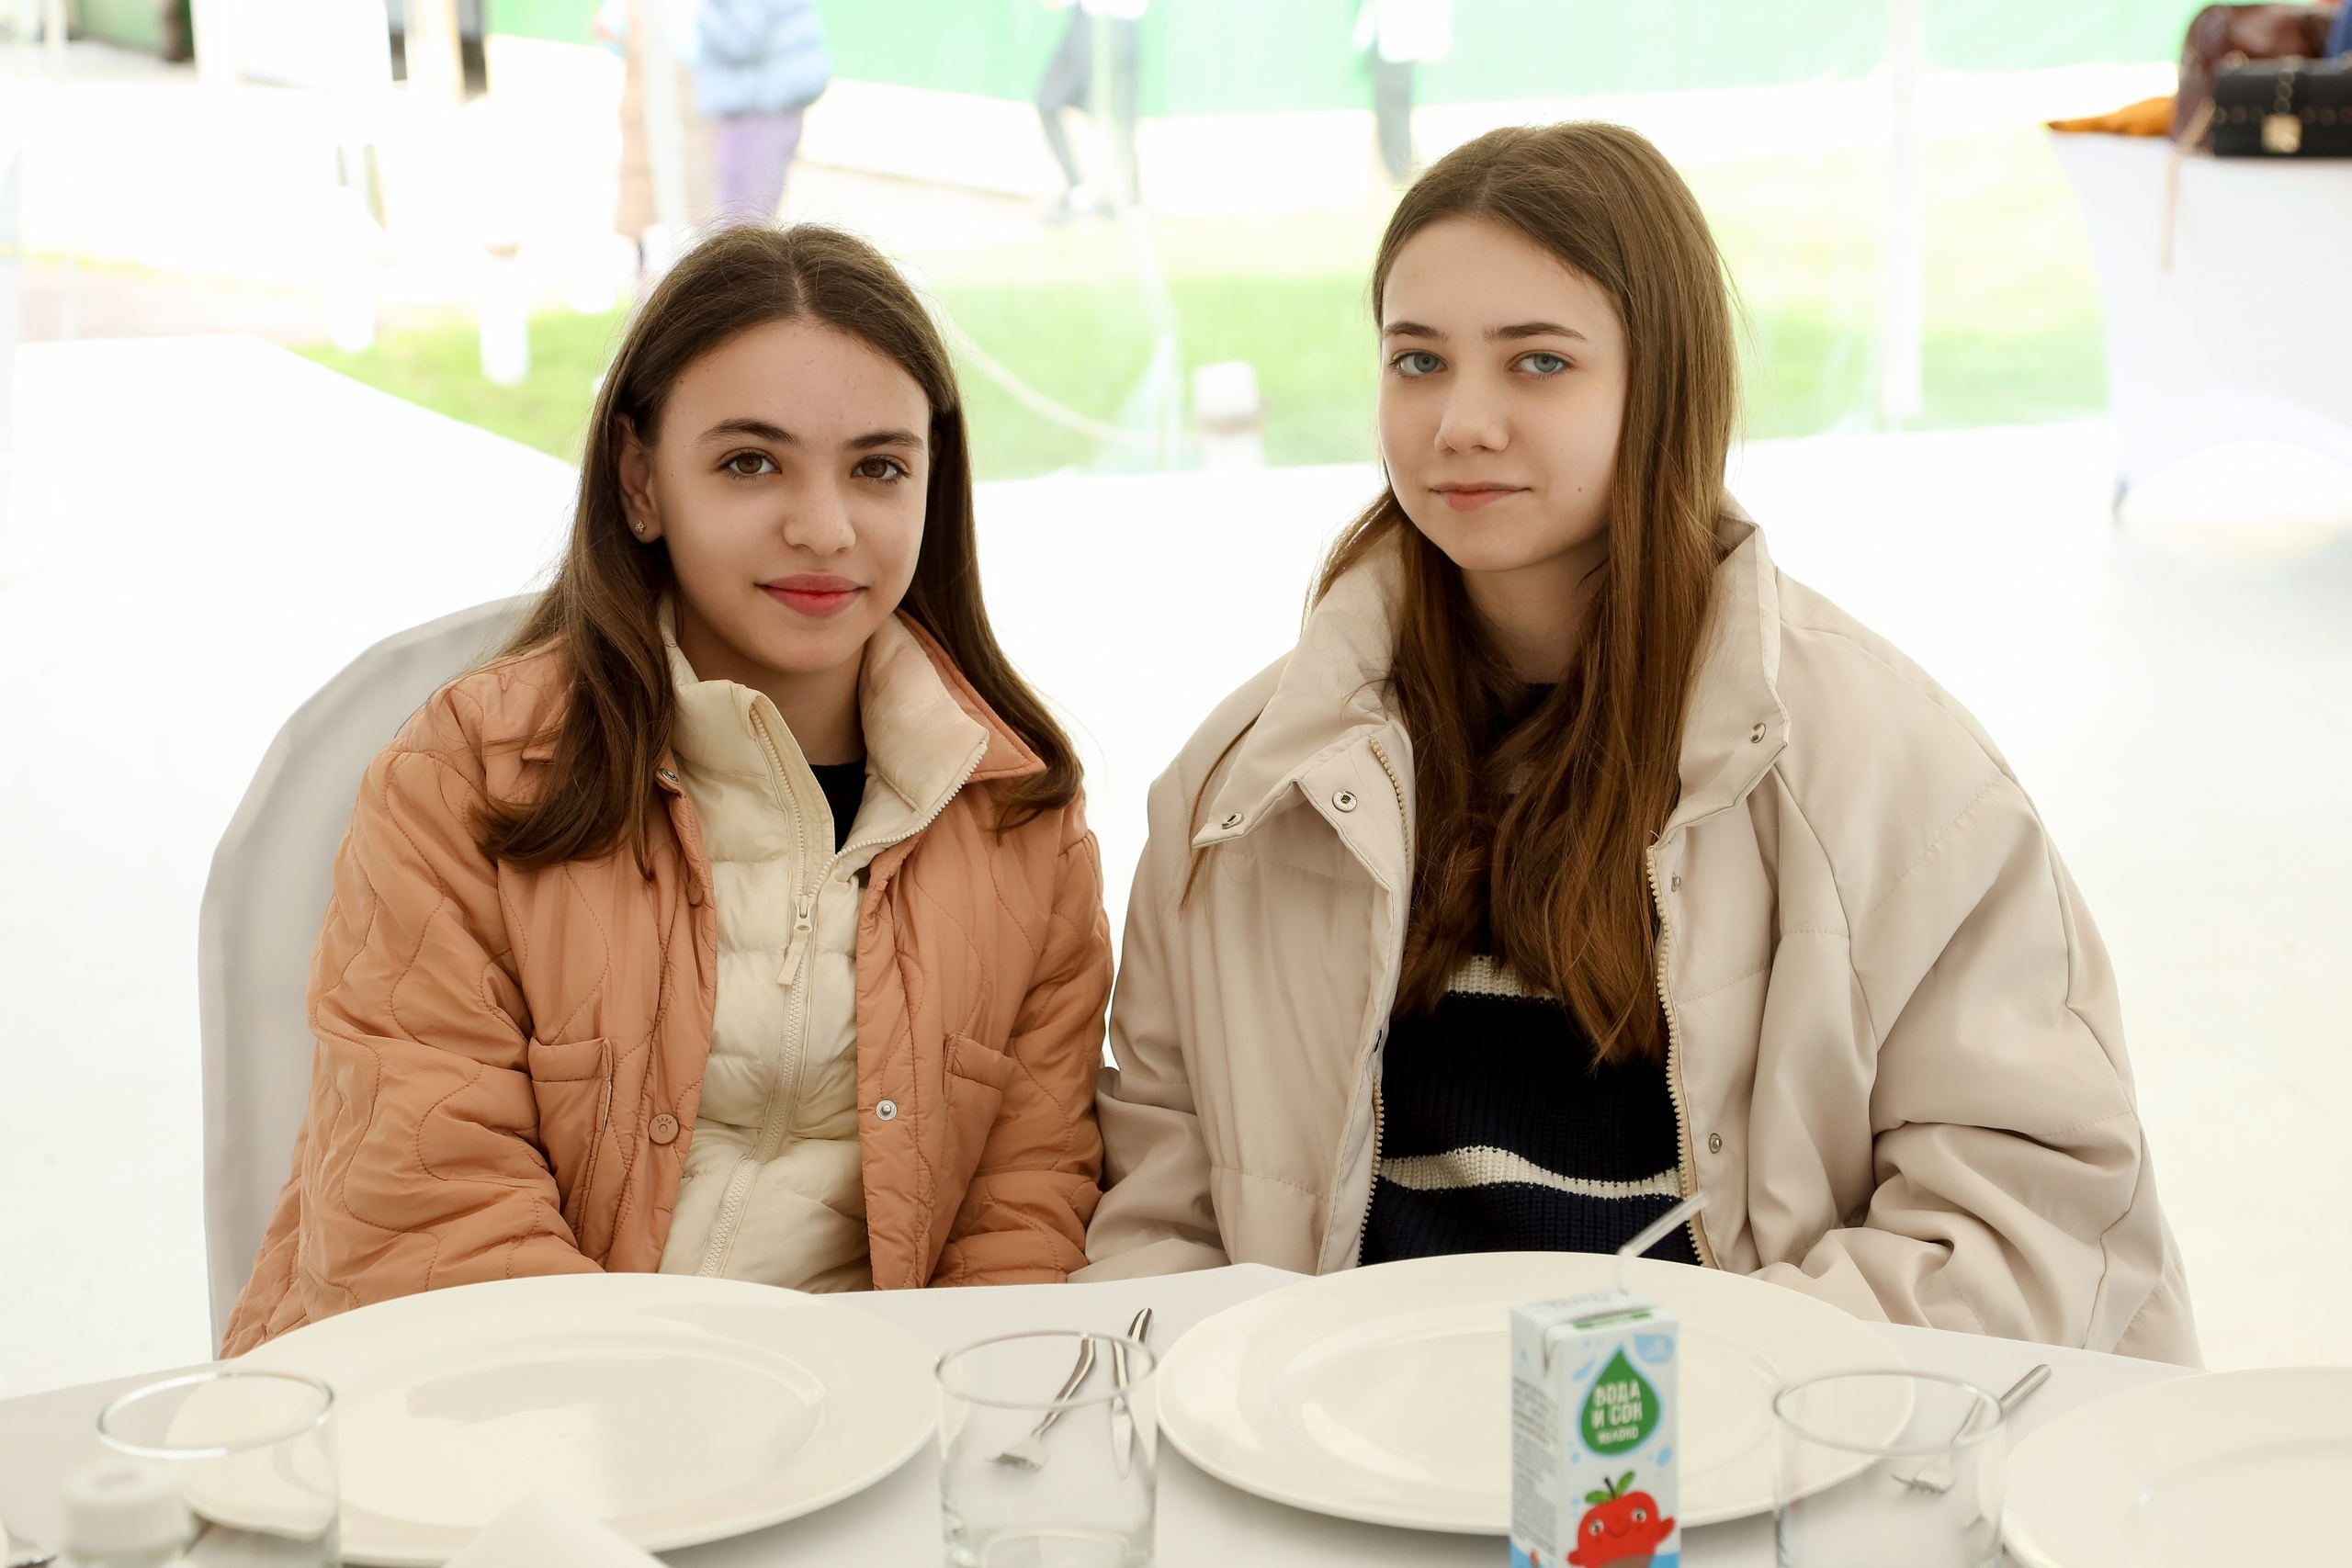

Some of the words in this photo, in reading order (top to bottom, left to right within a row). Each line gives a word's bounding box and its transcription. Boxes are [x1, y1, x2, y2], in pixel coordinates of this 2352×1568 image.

[656, 1117, 673, 1125] ZARA
[1594, 1381, 1641, 1406] ВОДА
[1591, 1408, 1605, 1429] И
[1609, 1401, 1643, 1426] СОК
[1598, 1426, 1639, 1445] ЯБЛОКО
